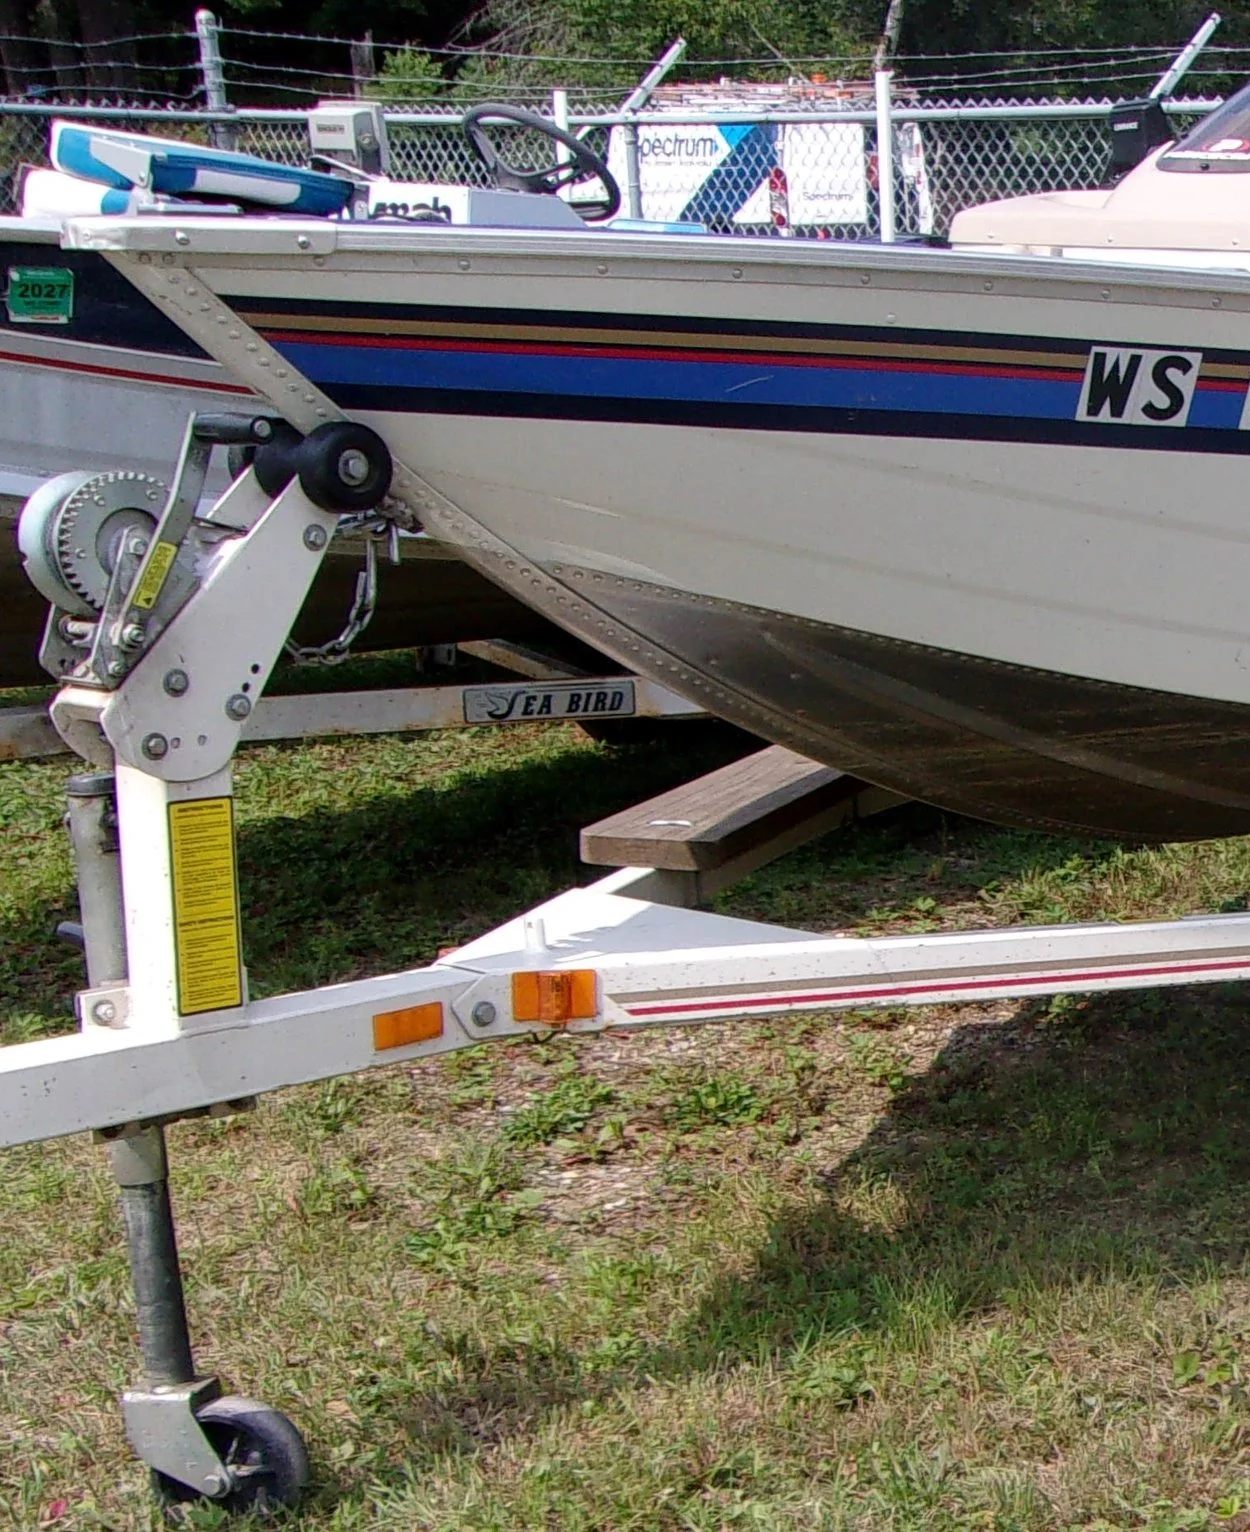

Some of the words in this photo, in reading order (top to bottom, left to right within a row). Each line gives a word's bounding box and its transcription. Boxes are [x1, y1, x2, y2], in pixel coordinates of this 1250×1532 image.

[637, 131, 714, 164] pectrum
[18, 283, 71, 299] 2027
[1085, 351, 1193, 421] WS
[486, 690, 553, 720] SEA
[566, 691, 625, 714] BIRD
